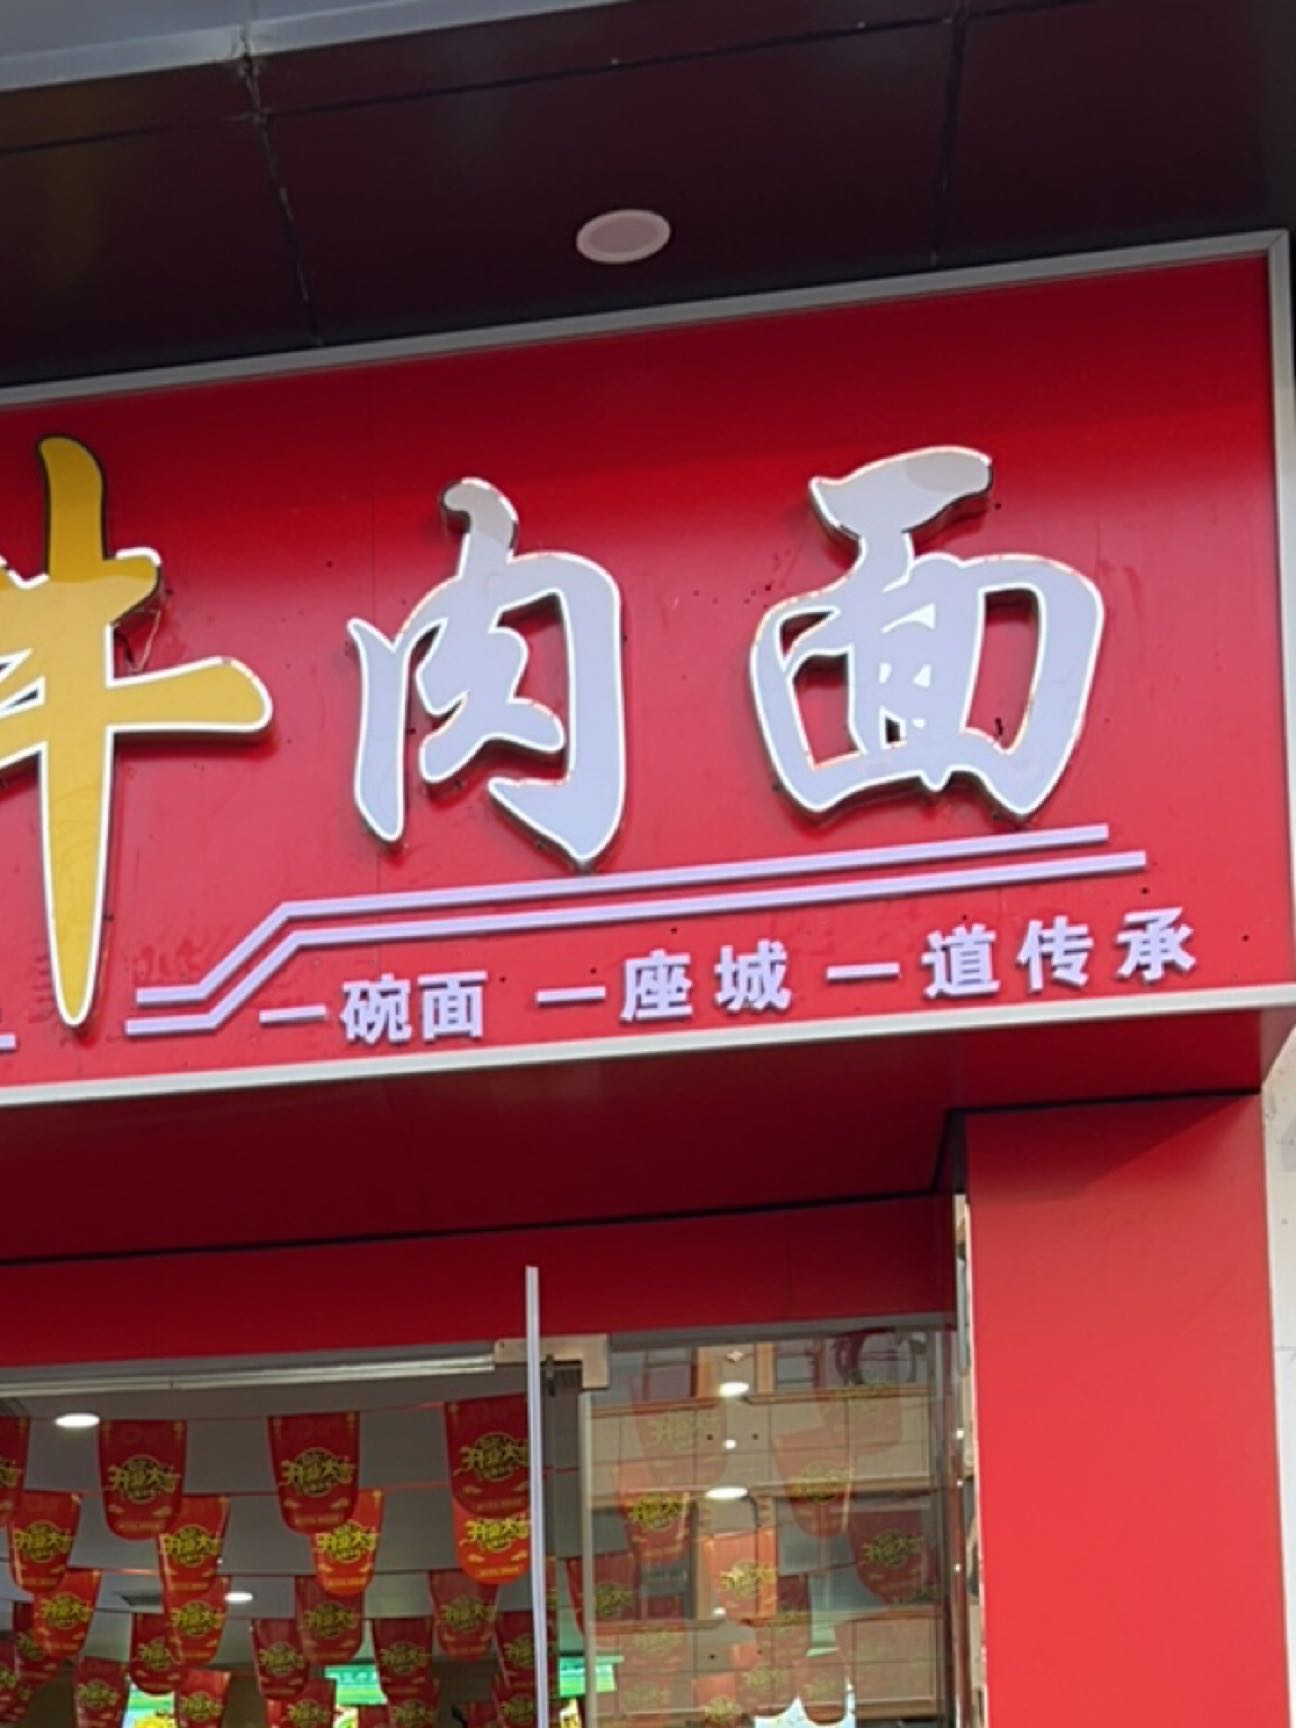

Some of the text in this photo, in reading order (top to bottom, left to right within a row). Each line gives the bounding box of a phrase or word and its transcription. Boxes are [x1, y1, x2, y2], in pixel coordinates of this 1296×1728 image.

[259, 905, 1198, 1045] 一碗面 一座城 一道传承
